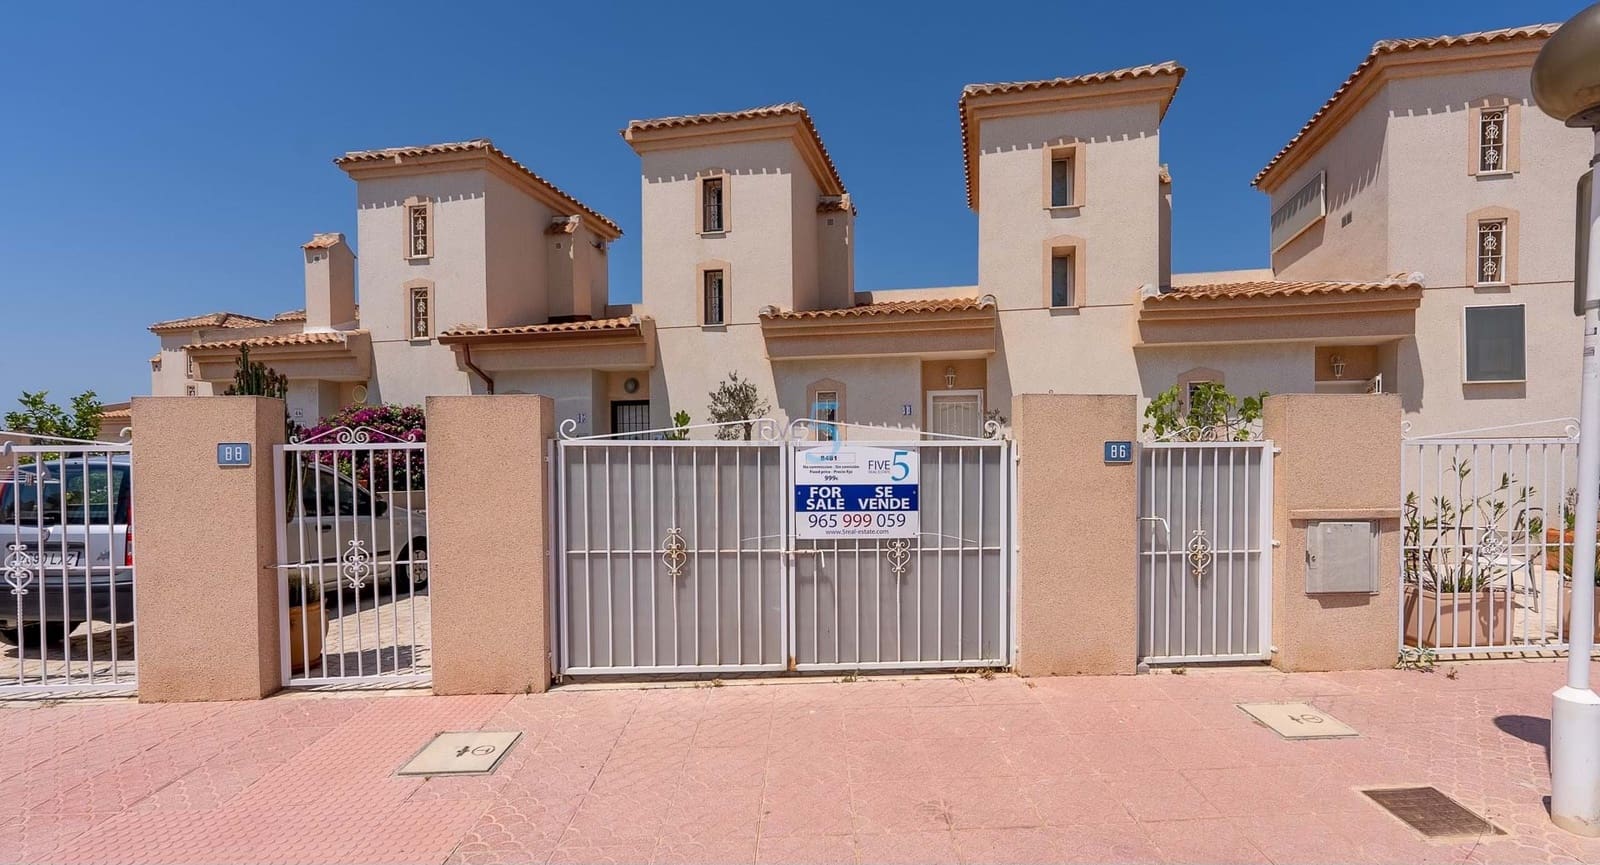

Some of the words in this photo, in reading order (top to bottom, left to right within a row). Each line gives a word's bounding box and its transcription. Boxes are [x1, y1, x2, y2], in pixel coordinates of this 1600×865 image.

[225, 446, 242, 461] 88
[1110, 444, 1126, 458] 86
[868, 460, 890, 470] FIVE
[891, 451, 910, 481] 5
[809, 486, 842, 498] FOR
[875, 486, 893, 498] SE
[806, 498, 845, 510] SALE
[858, 498, 910, 510] VENDE
[808, 514, 838, 528] 965
[842, 513, 872, 528] 999
[876, 513, 906, 528] 059
